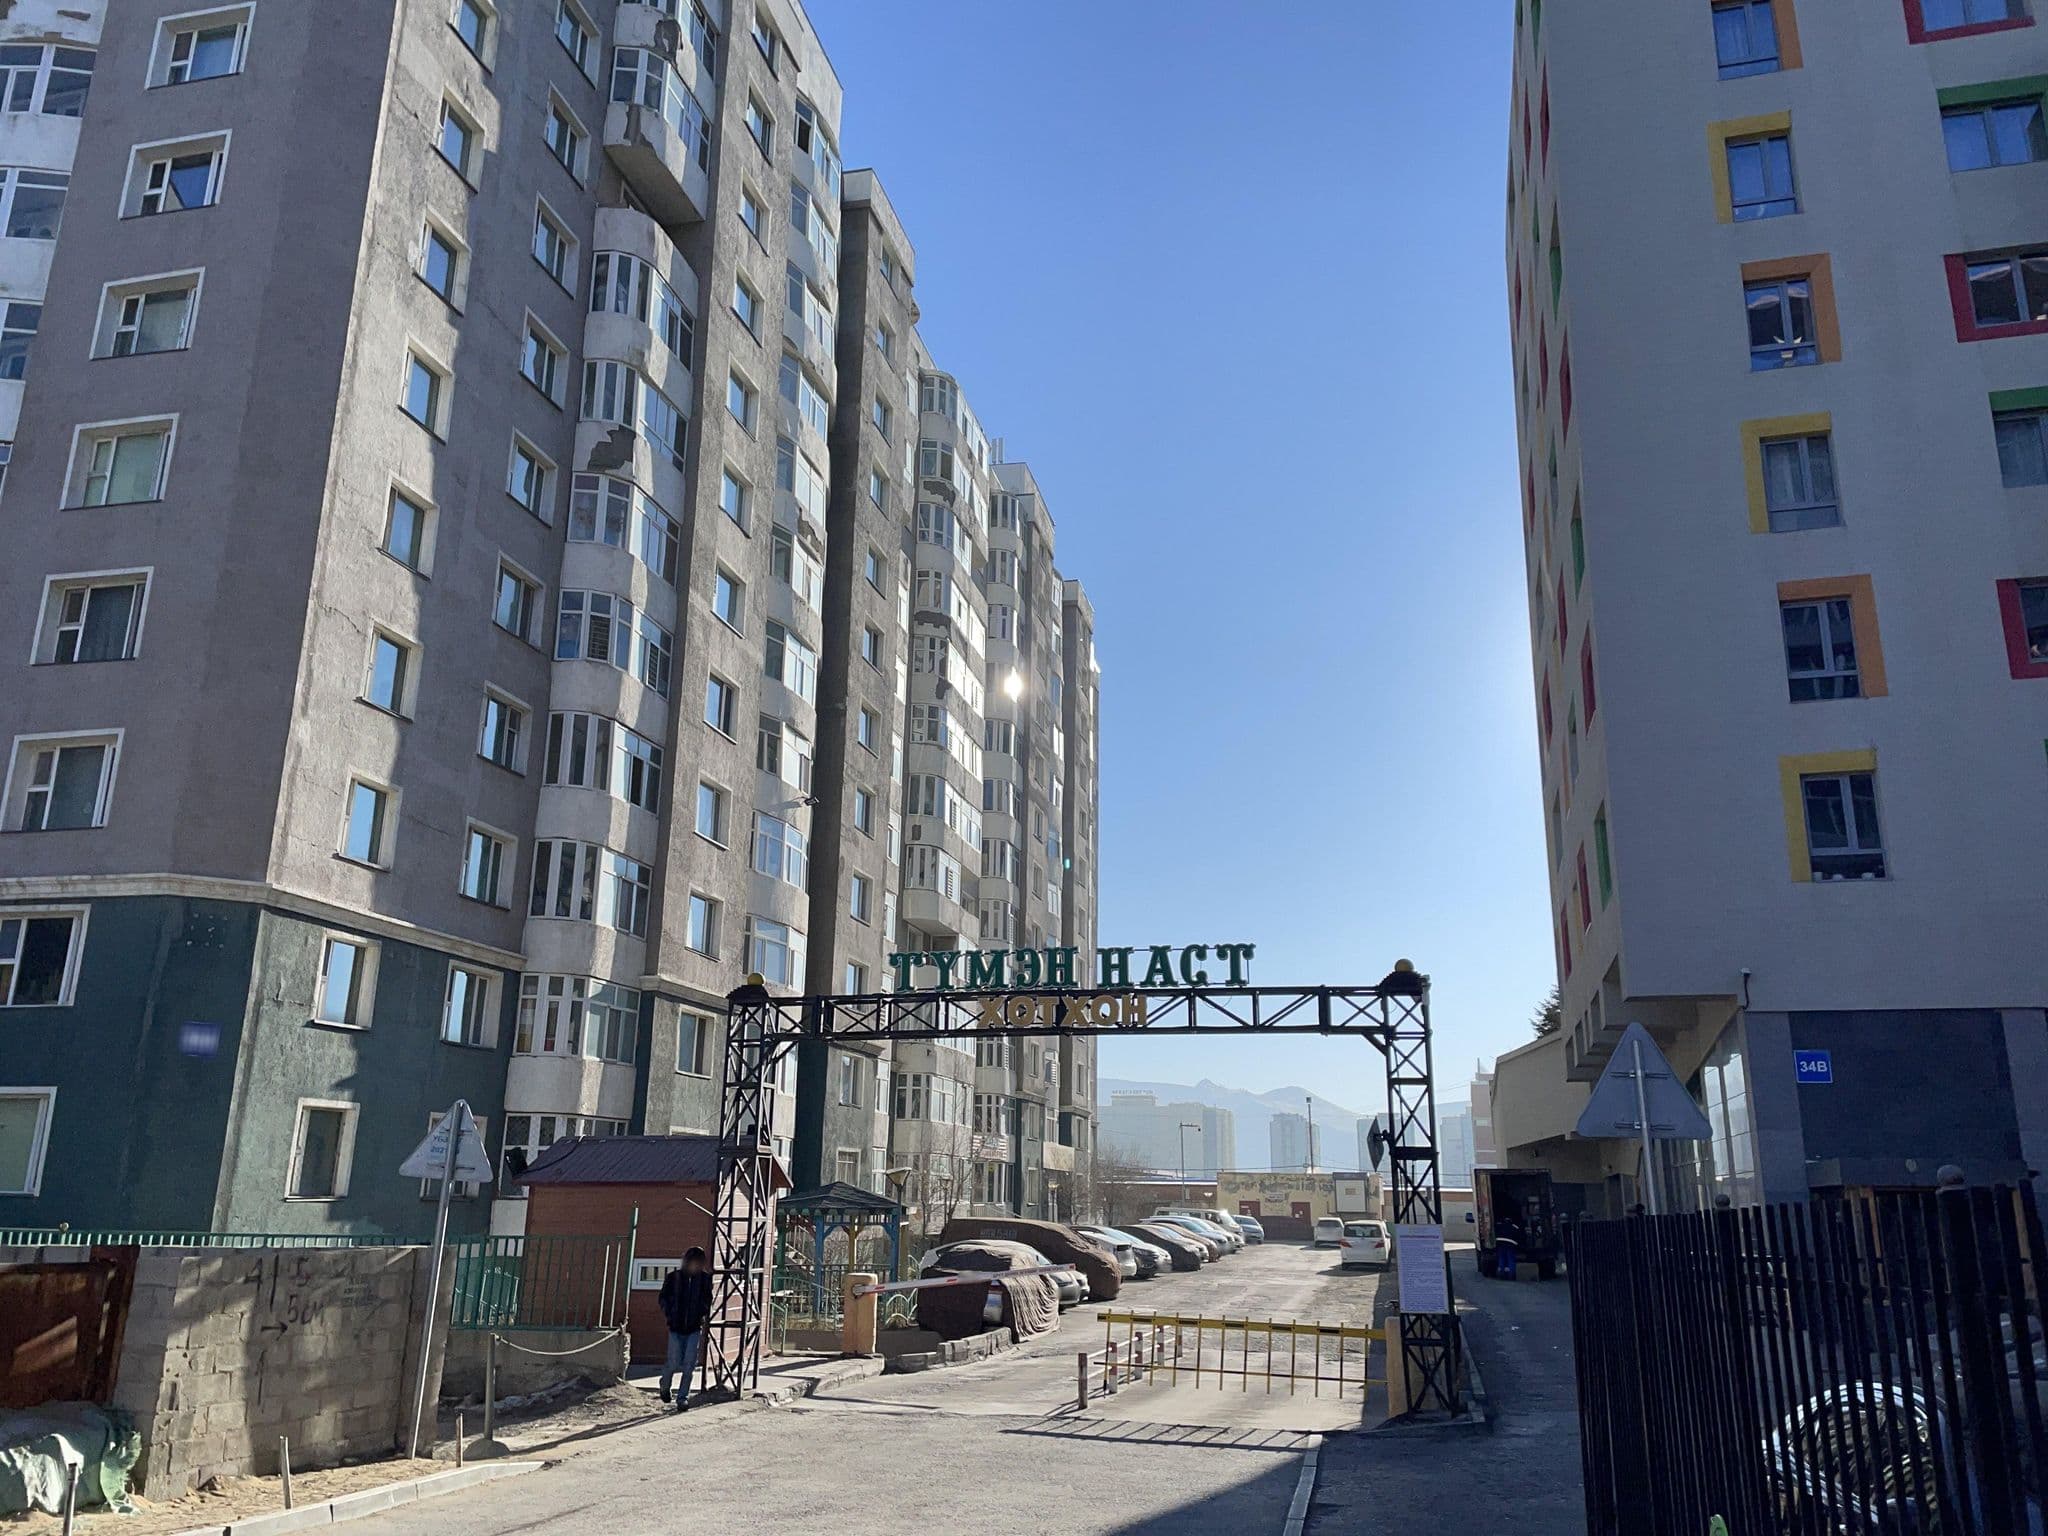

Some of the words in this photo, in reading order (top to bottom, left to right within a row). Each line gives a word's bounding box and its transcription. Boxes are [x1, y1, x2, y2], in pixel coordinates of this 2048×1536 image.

[888, 946, 1080, 993] ТҮМЭН
[1096, 943, 1257, 988] НАСТ
[975, 995, 1148, 1028] ХОТХОН
